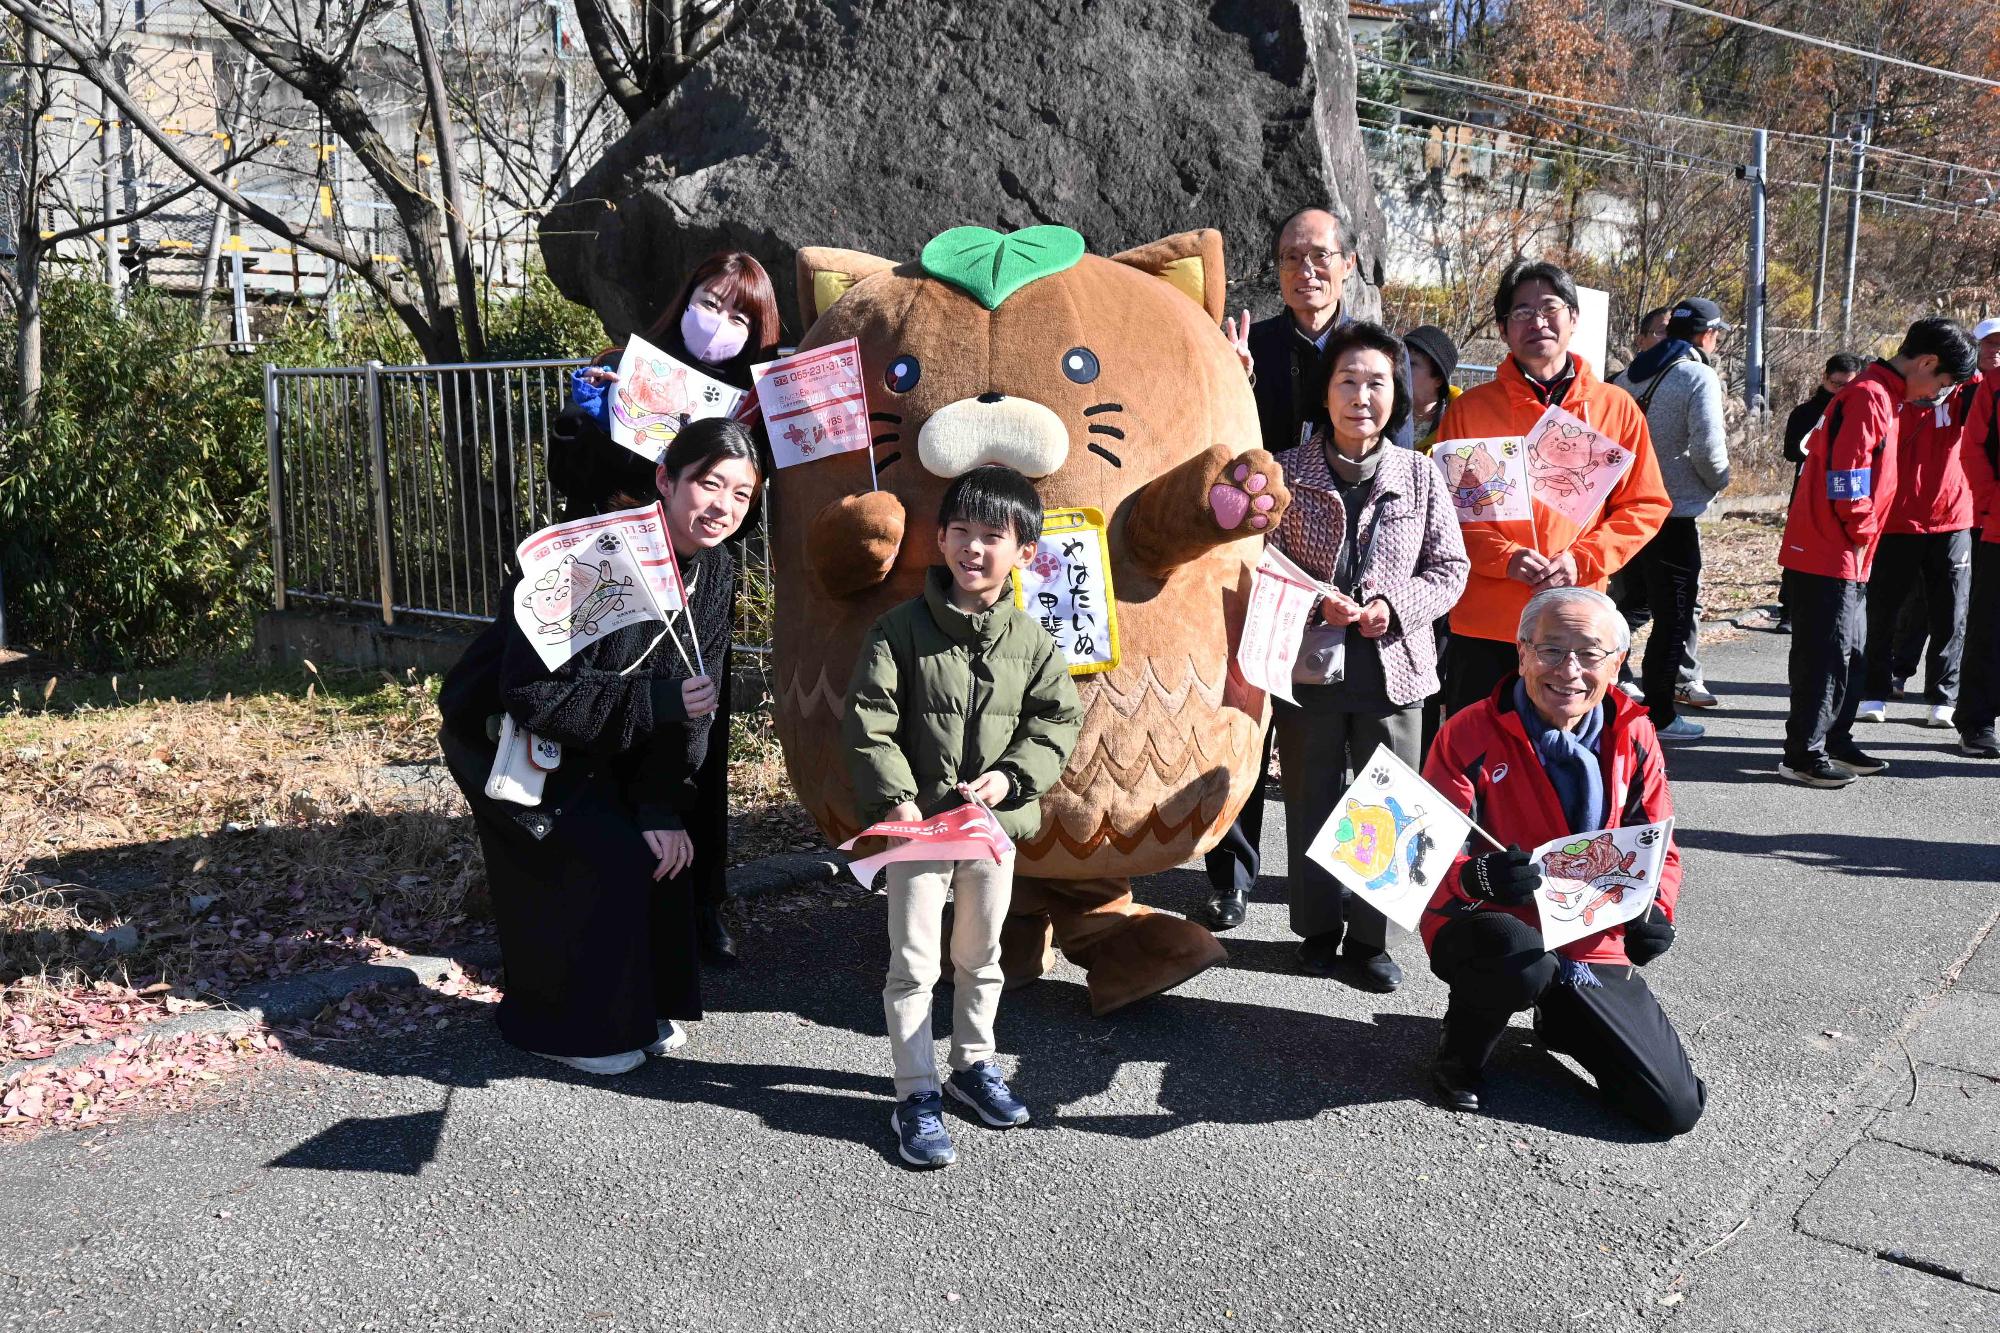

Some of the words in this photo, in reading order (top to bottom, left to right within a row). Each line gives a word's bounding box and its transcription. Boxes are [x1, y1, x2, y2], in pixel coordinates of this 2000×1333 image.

[790, 356, 854, 382] 055-231-3132
[827, 415, 842, 427] YBS
[1833, 476, 1862, 492] 監督
[1062, 537, 1096, 655] やはたいぬ
[1038, 592, 1066, 649] 甲斐
